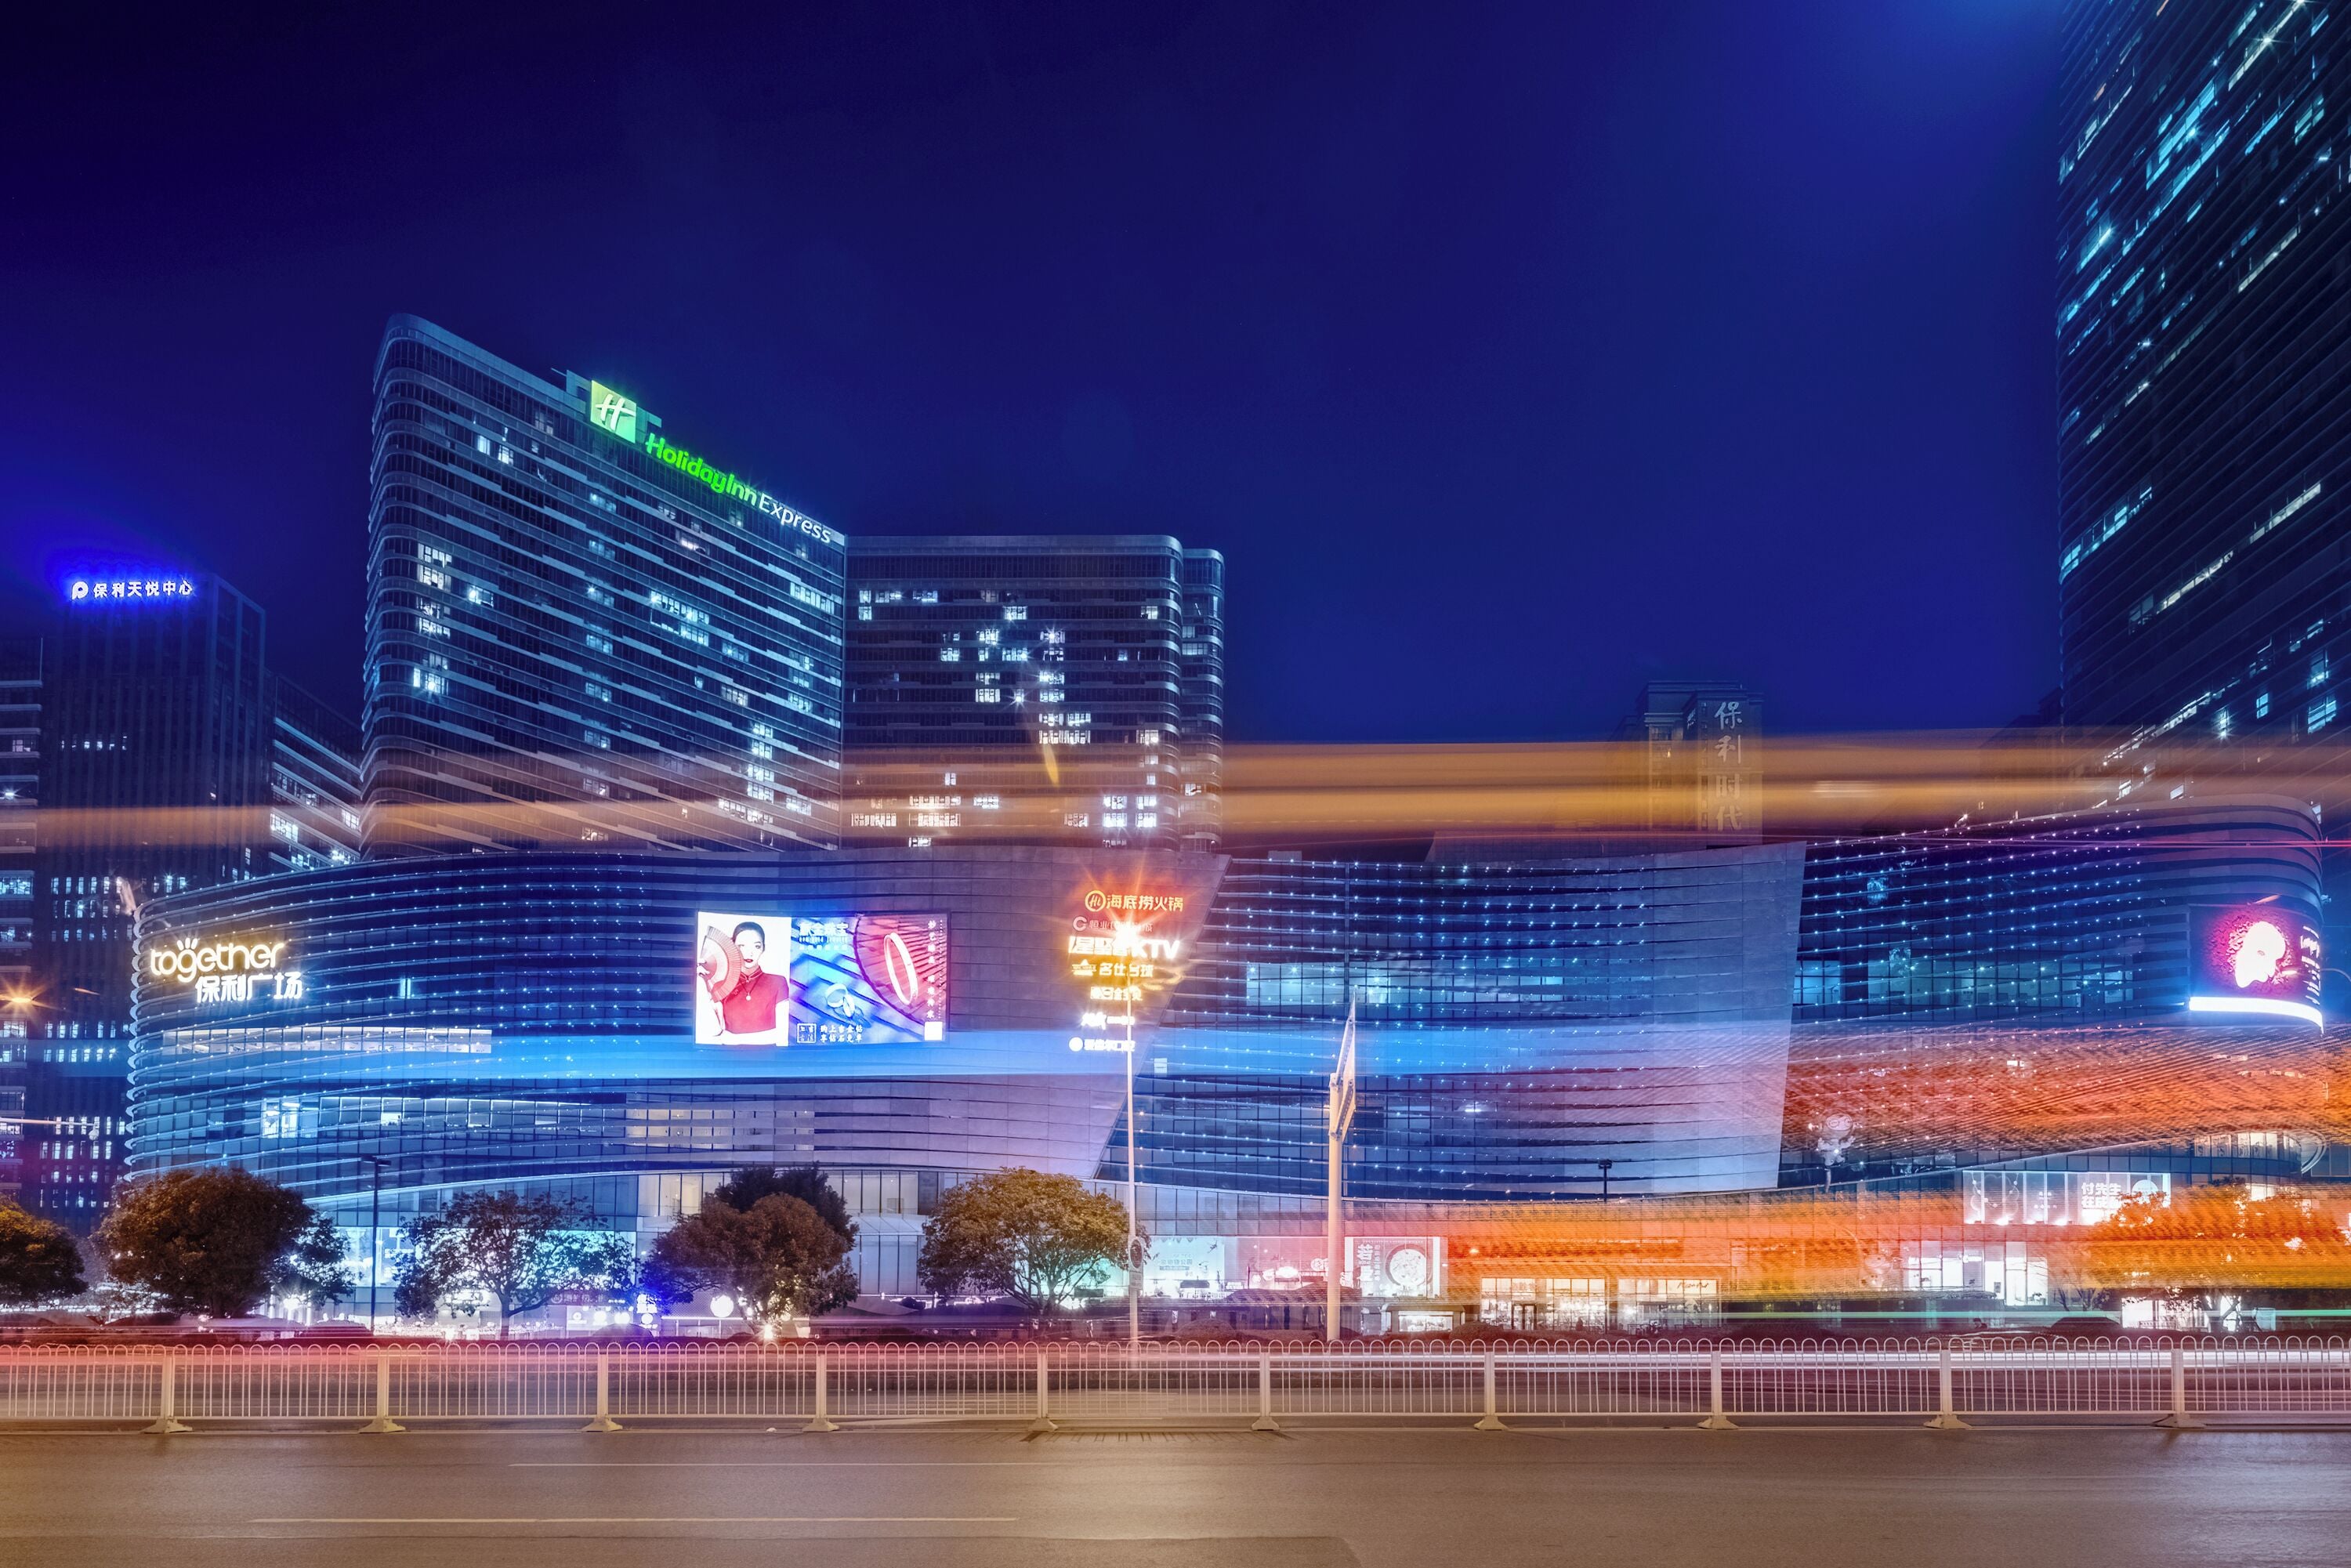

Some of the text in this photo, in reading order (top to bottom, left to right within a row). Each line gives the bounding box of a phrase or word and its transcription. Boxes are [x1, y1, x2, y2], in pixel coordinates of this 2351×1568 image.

[759, 493, 831, 544] Express
[93, 580, 193, 598] 保利天悦中心
[1106, 894, 1183, 912] 海底捞火锅
[150, 942, 284, 983] together
[195, 972, 302, 1003] 保利广场
[2081, 1182, 2121, 1196] 付先生
